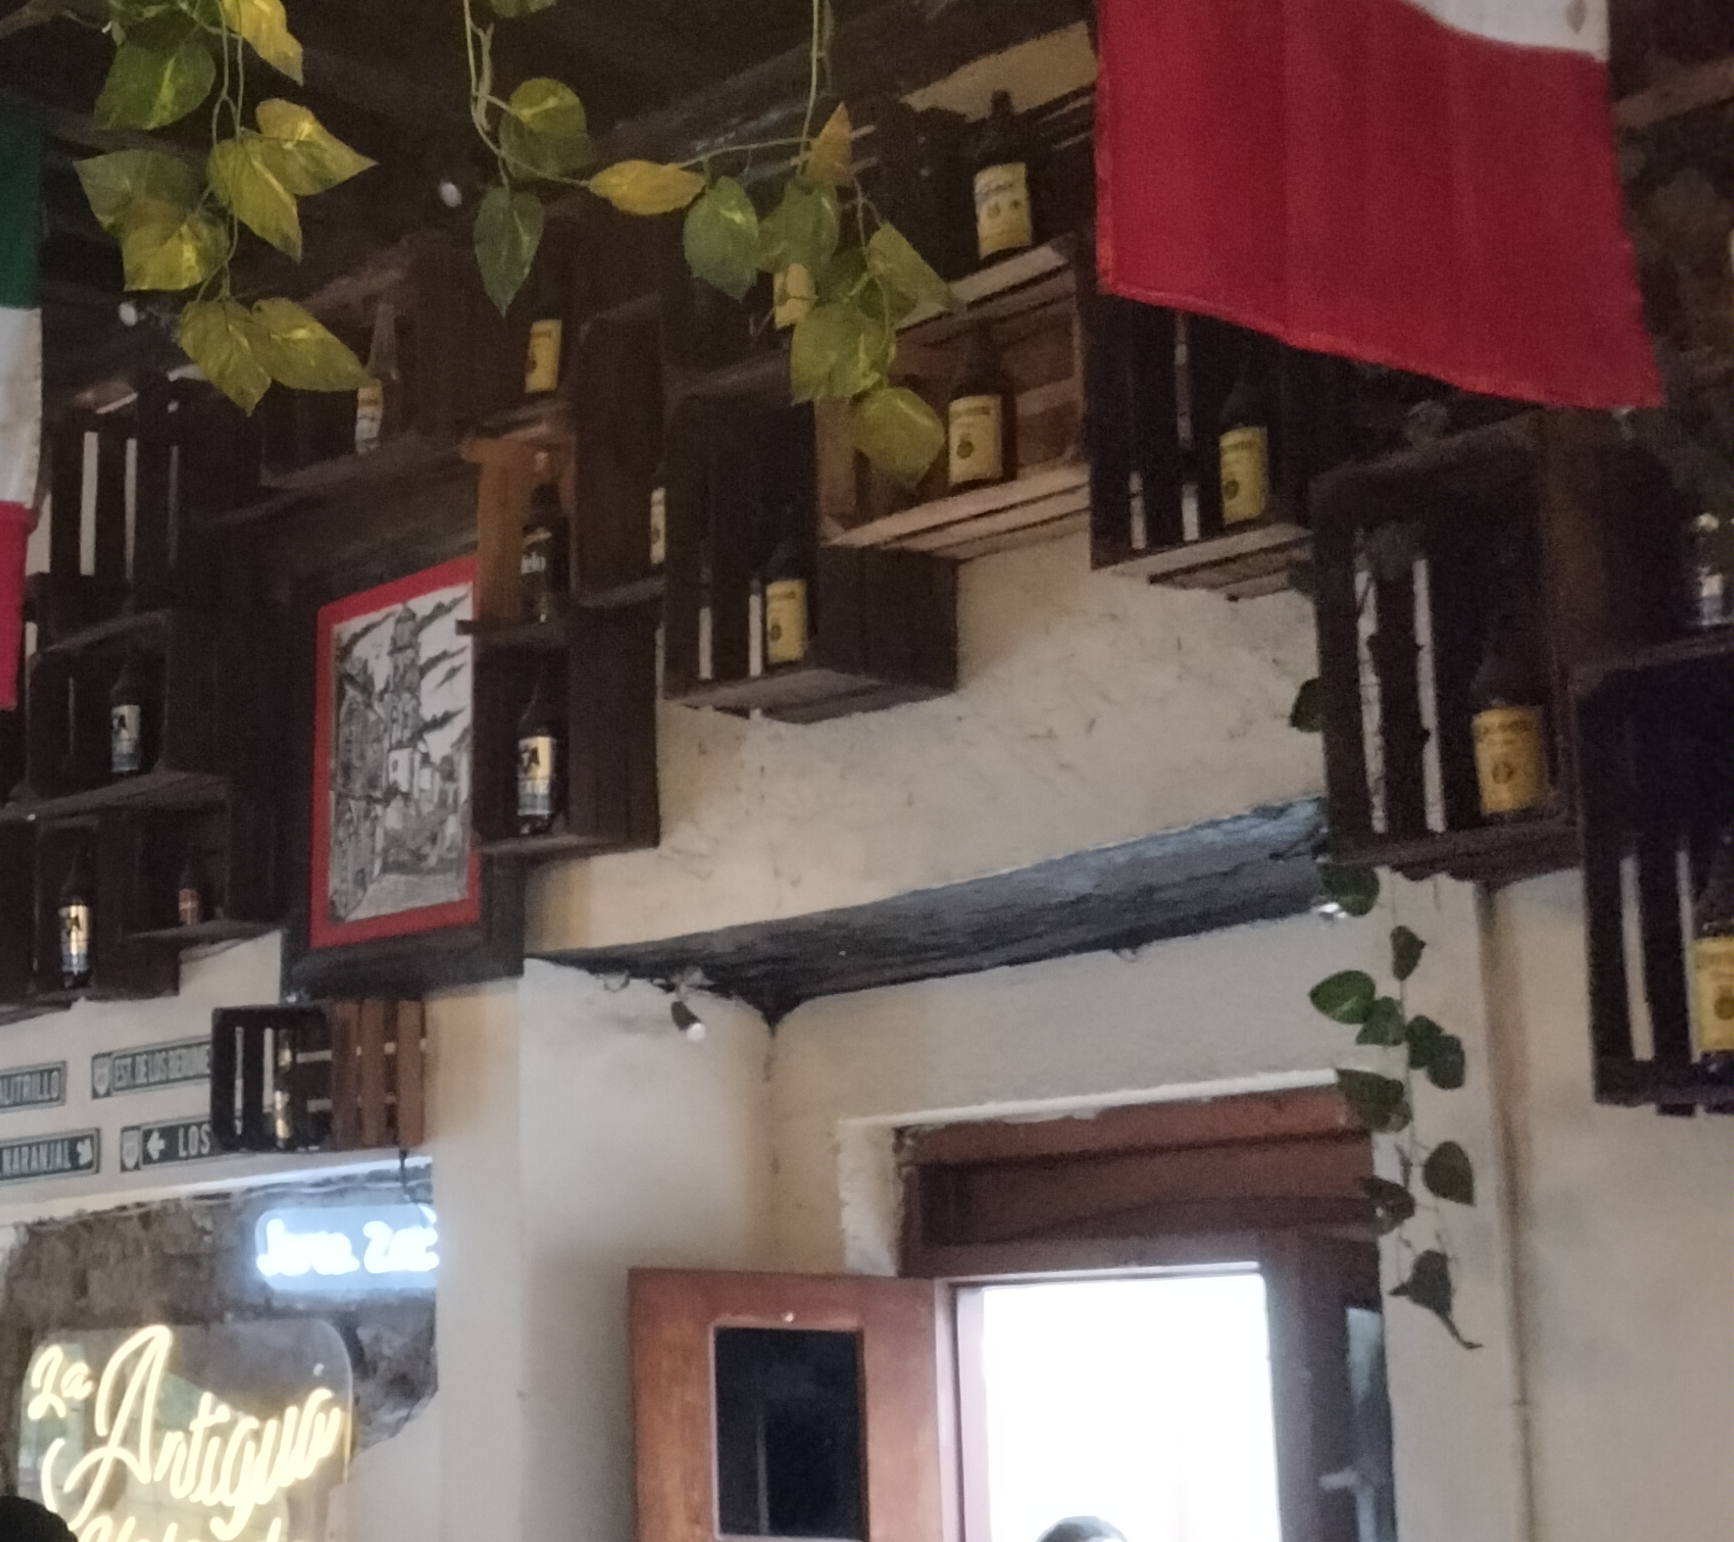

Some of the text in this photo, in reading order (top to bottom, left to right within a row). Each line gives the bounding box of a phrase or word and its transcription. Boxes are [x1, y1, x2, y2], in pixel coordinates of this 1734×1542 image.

[177, 1123, 211, 1159] LOS
[27, 1343, 95, 1421] La
[41, 1324, 343, 1542] Antigua
